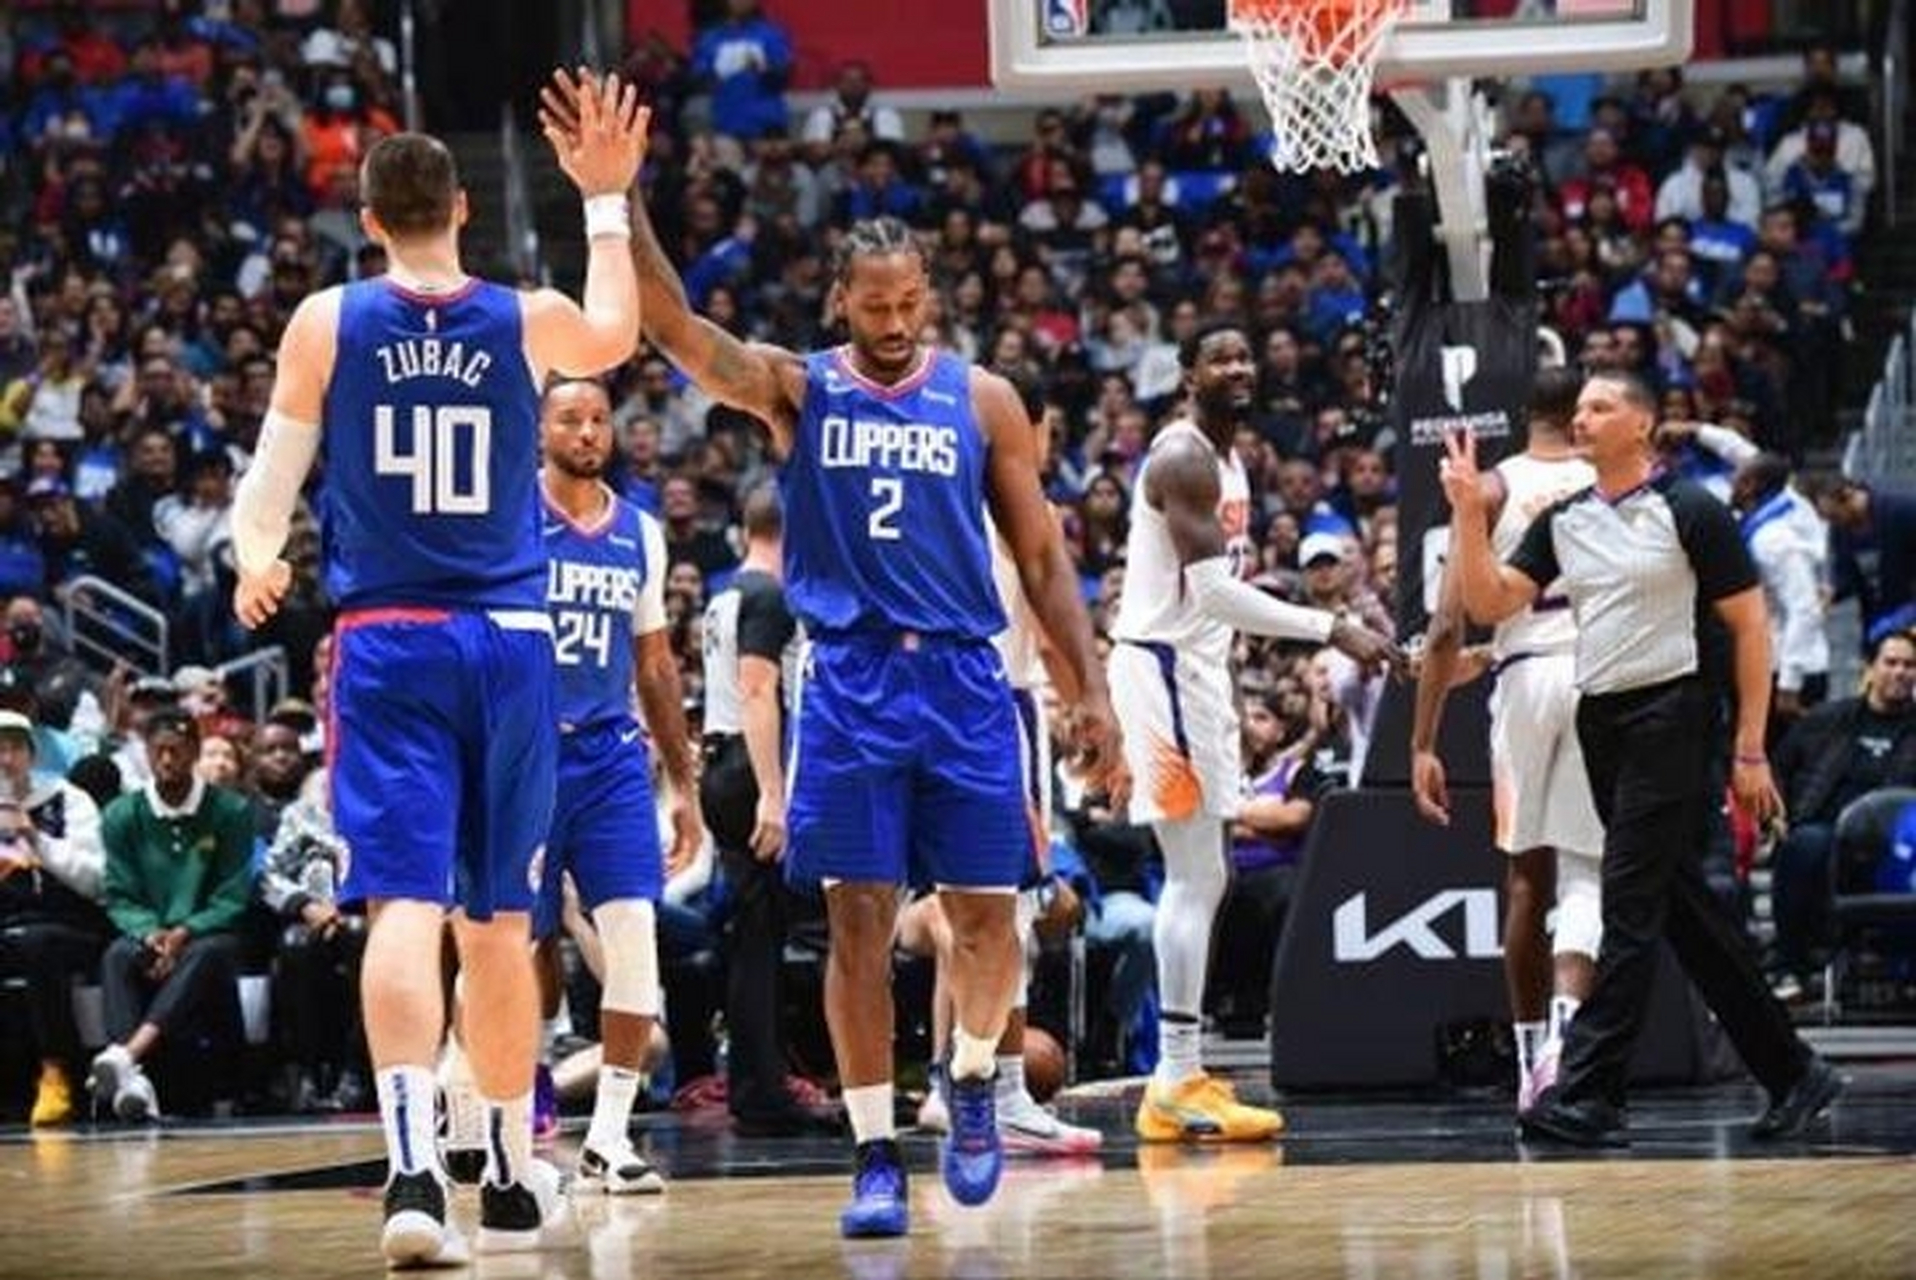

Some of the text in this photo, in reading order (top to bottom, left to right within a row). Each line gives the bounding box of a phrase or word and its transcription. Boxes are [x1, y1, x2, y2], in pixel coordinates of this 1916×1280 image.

[377, 339, 491, 387] ZUBAC
[375, 404, 491, 513] 40
[822, 417, 957, 476] CLIPPERS
[869, 478, 903, 539] 2
[549, 559, 638, 612] LIPPERS
[556, 611, 611, 668] 24
[1334, 889, 1506, 961] KI
